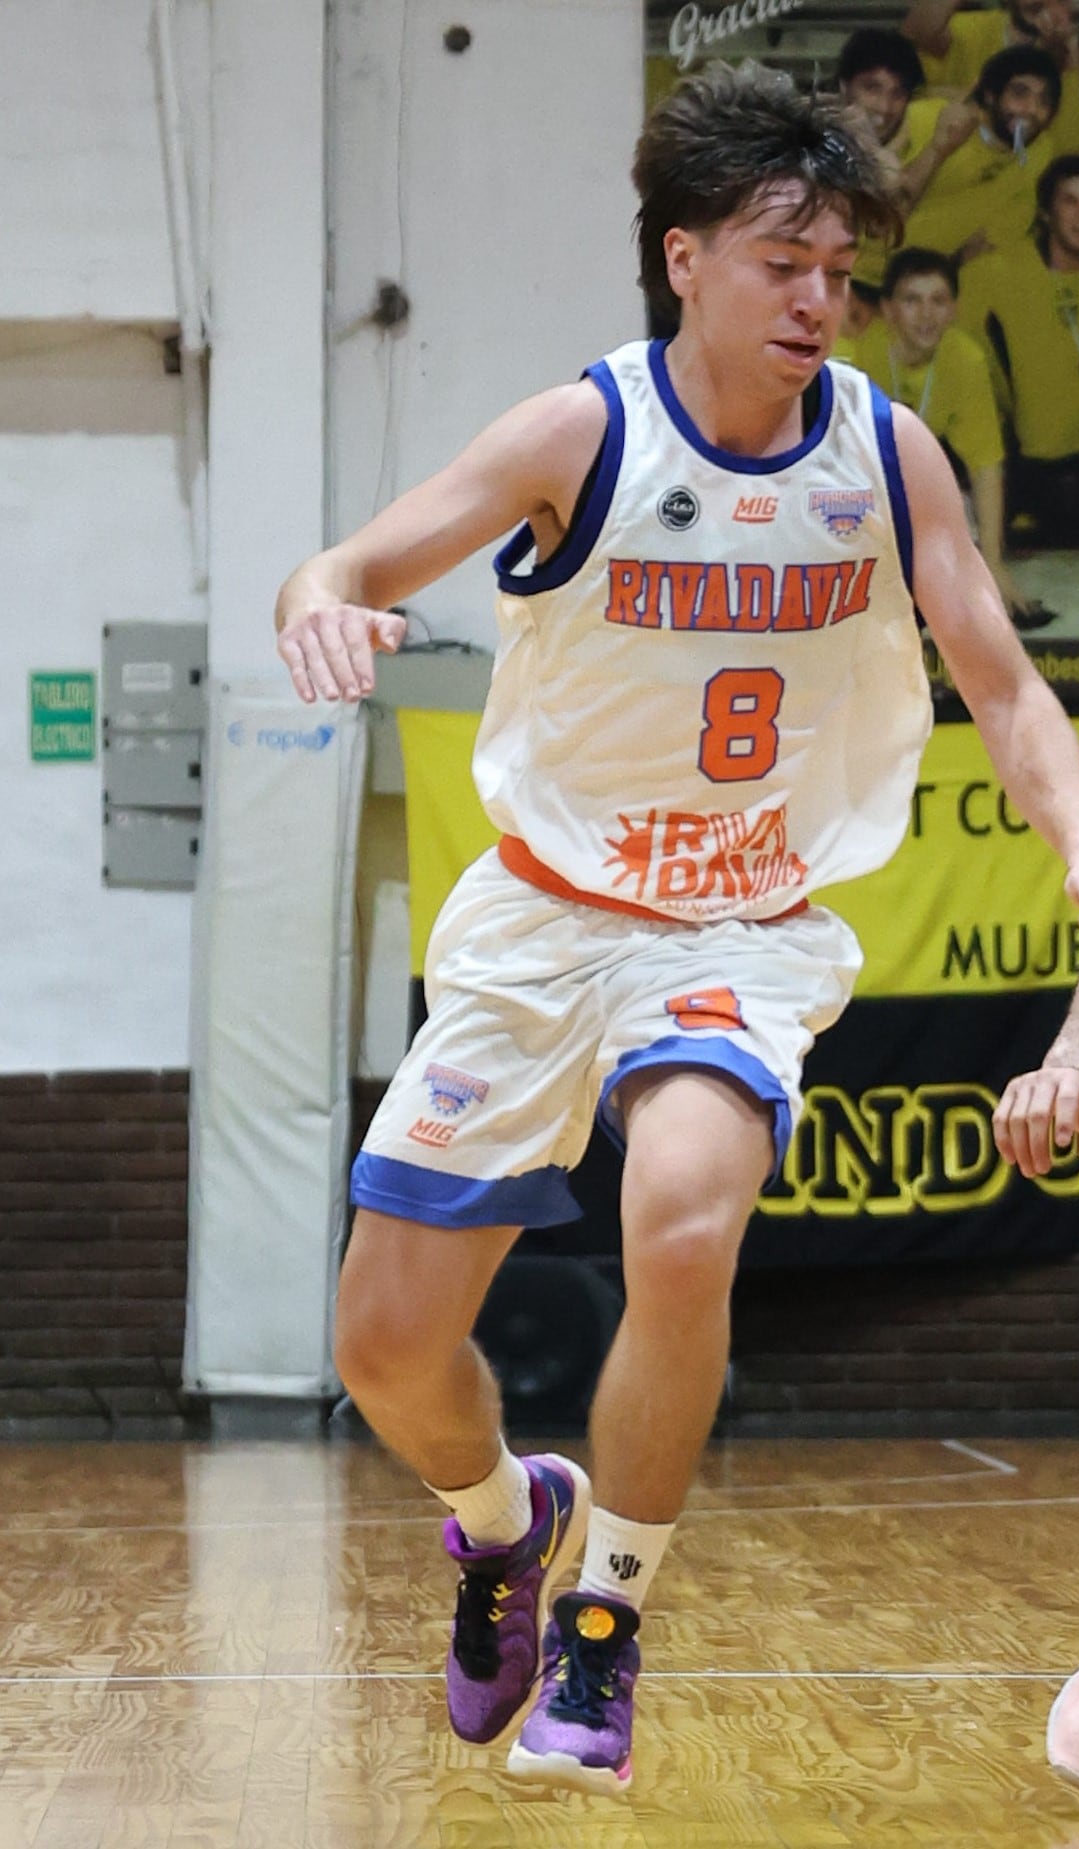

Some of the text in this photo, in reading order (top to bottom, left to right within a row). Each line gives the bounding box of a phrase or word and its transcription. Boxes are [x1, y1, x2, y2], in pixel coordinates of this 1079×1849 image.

[734, 496, 778, 519] MIG
[697, 667, 784, 783] 8
[409, 1116, 457, 1147] MIG
